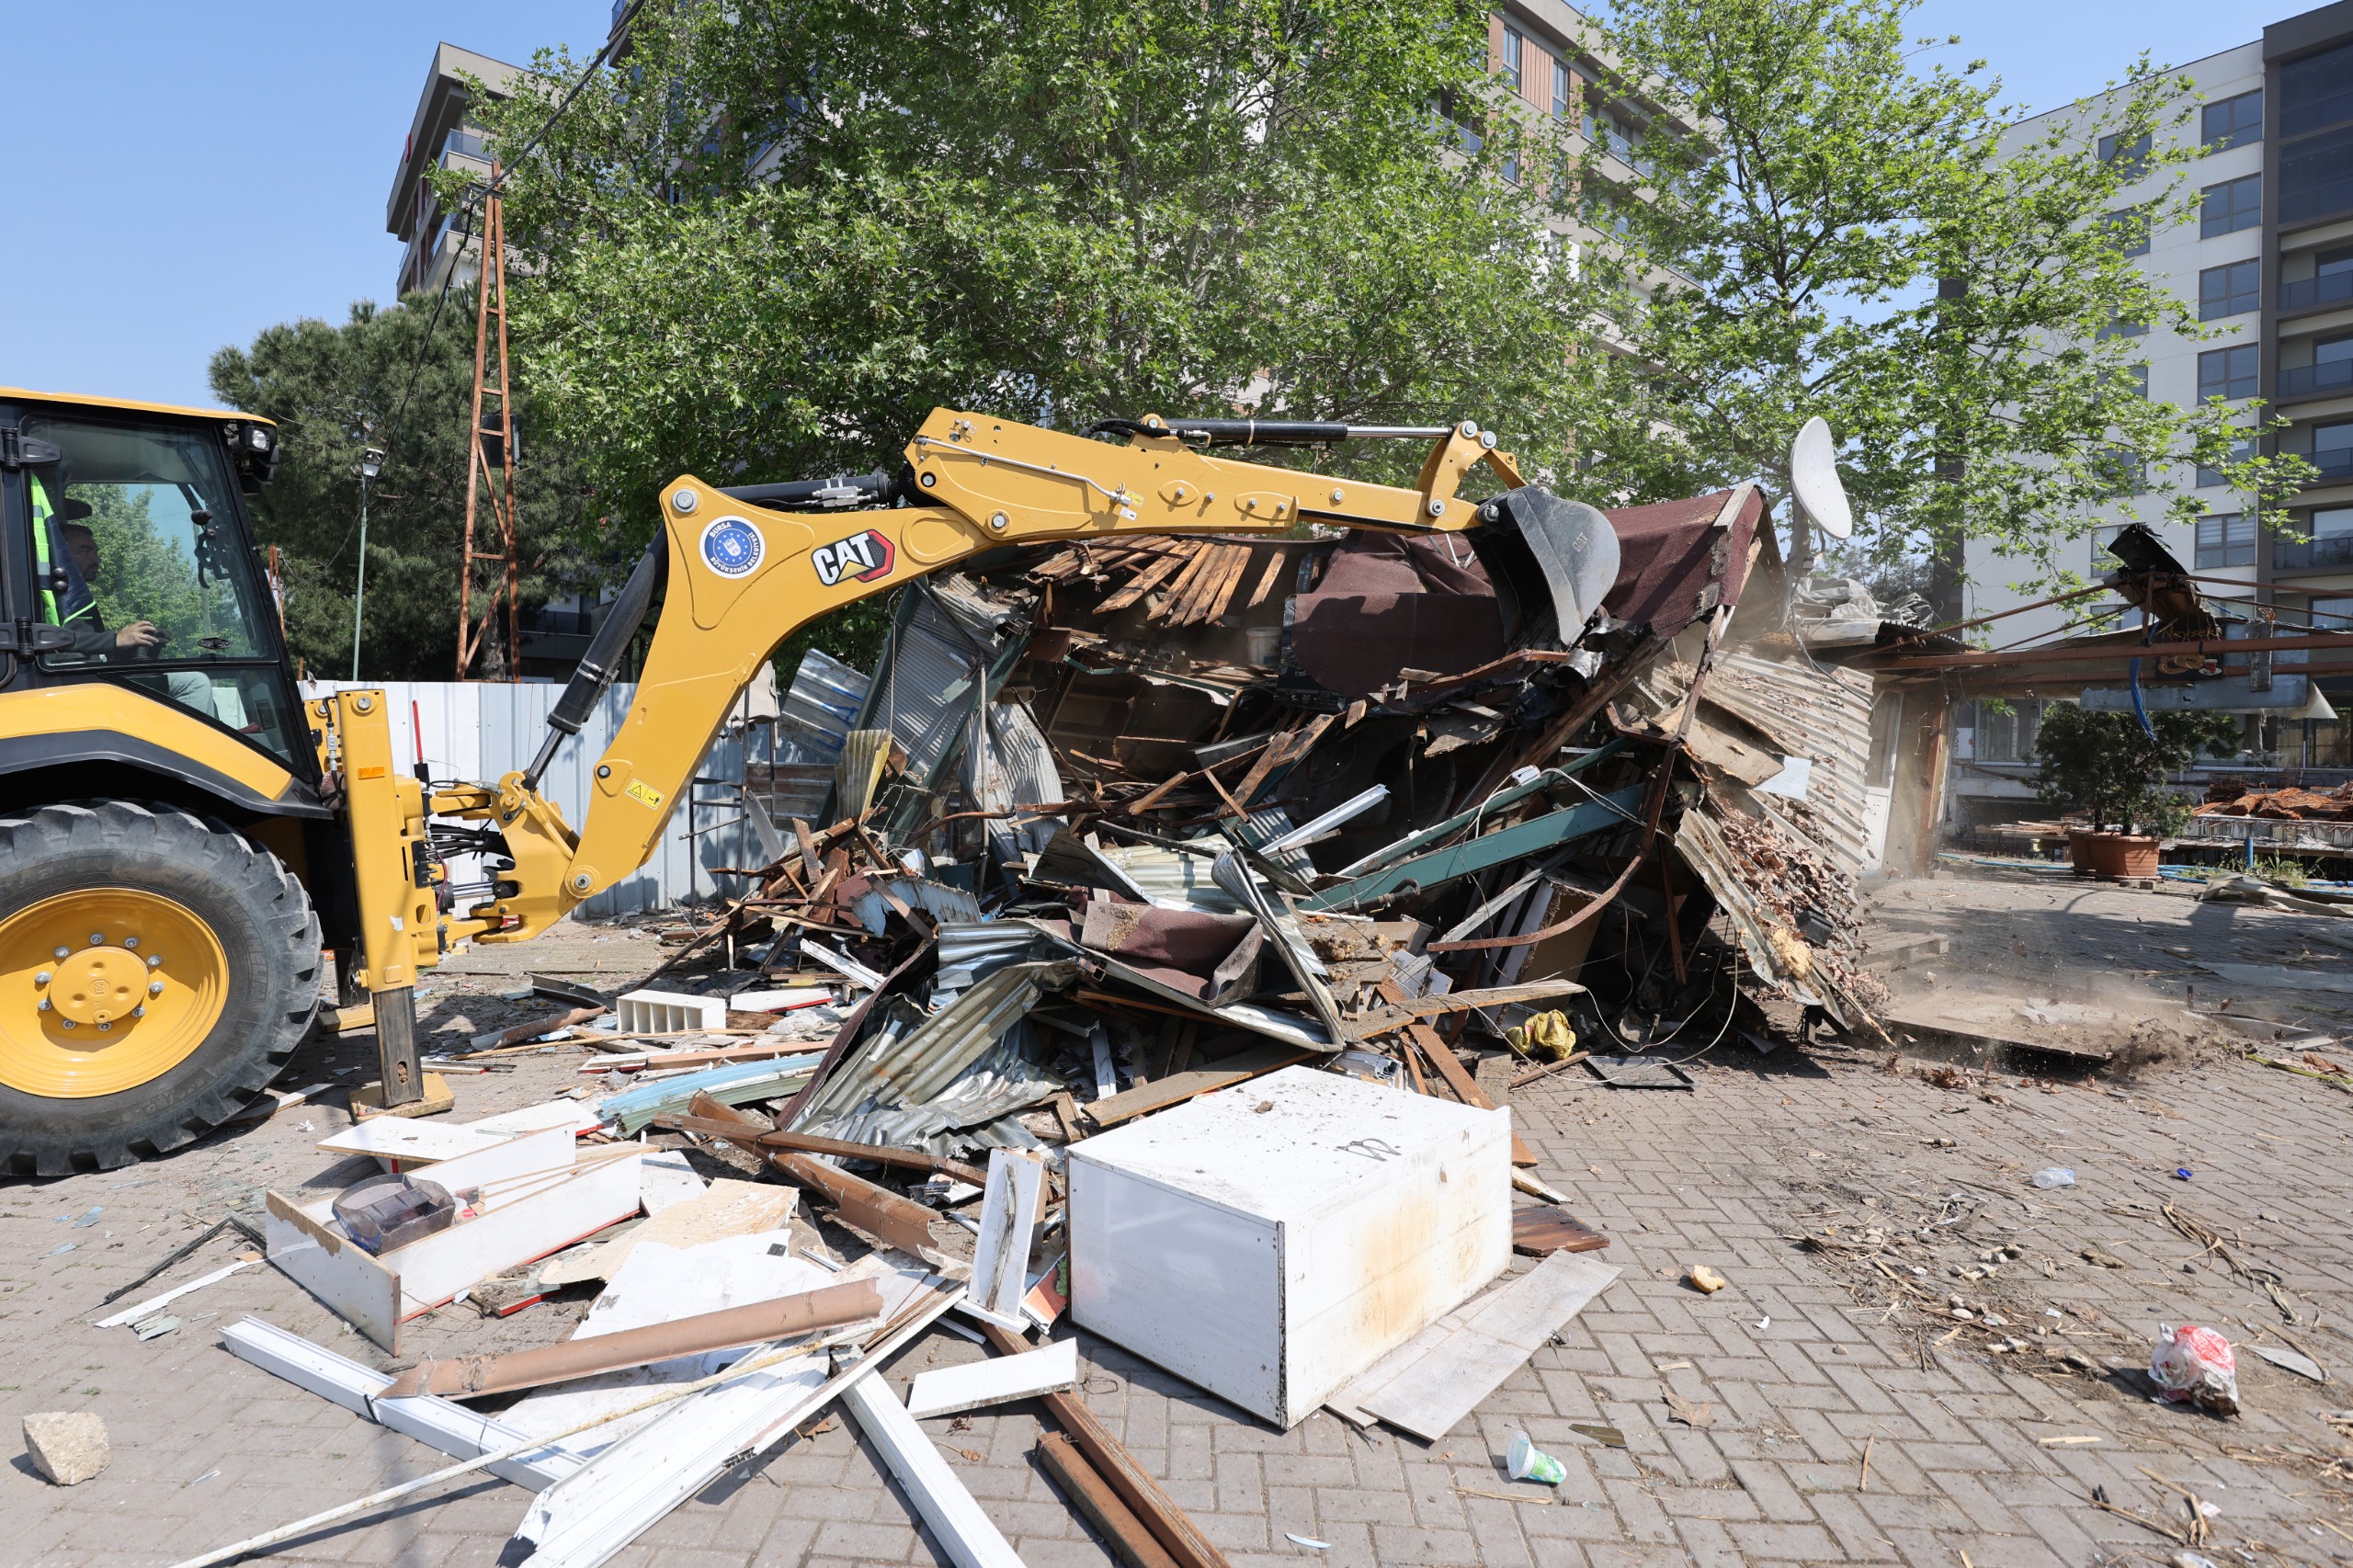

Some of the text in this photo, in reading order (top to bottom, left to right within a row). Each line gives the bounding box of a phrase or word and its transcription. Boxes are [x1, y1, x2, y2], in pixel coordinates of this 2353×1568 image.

[709, 521, 732, 538] BURSA
[1573, 532, 1588, 552] CAT
[710, 531, 760, 574] BÜYÜKŞEHİR BELEDİYESİ
[813, 532, 875, 585] CAT
